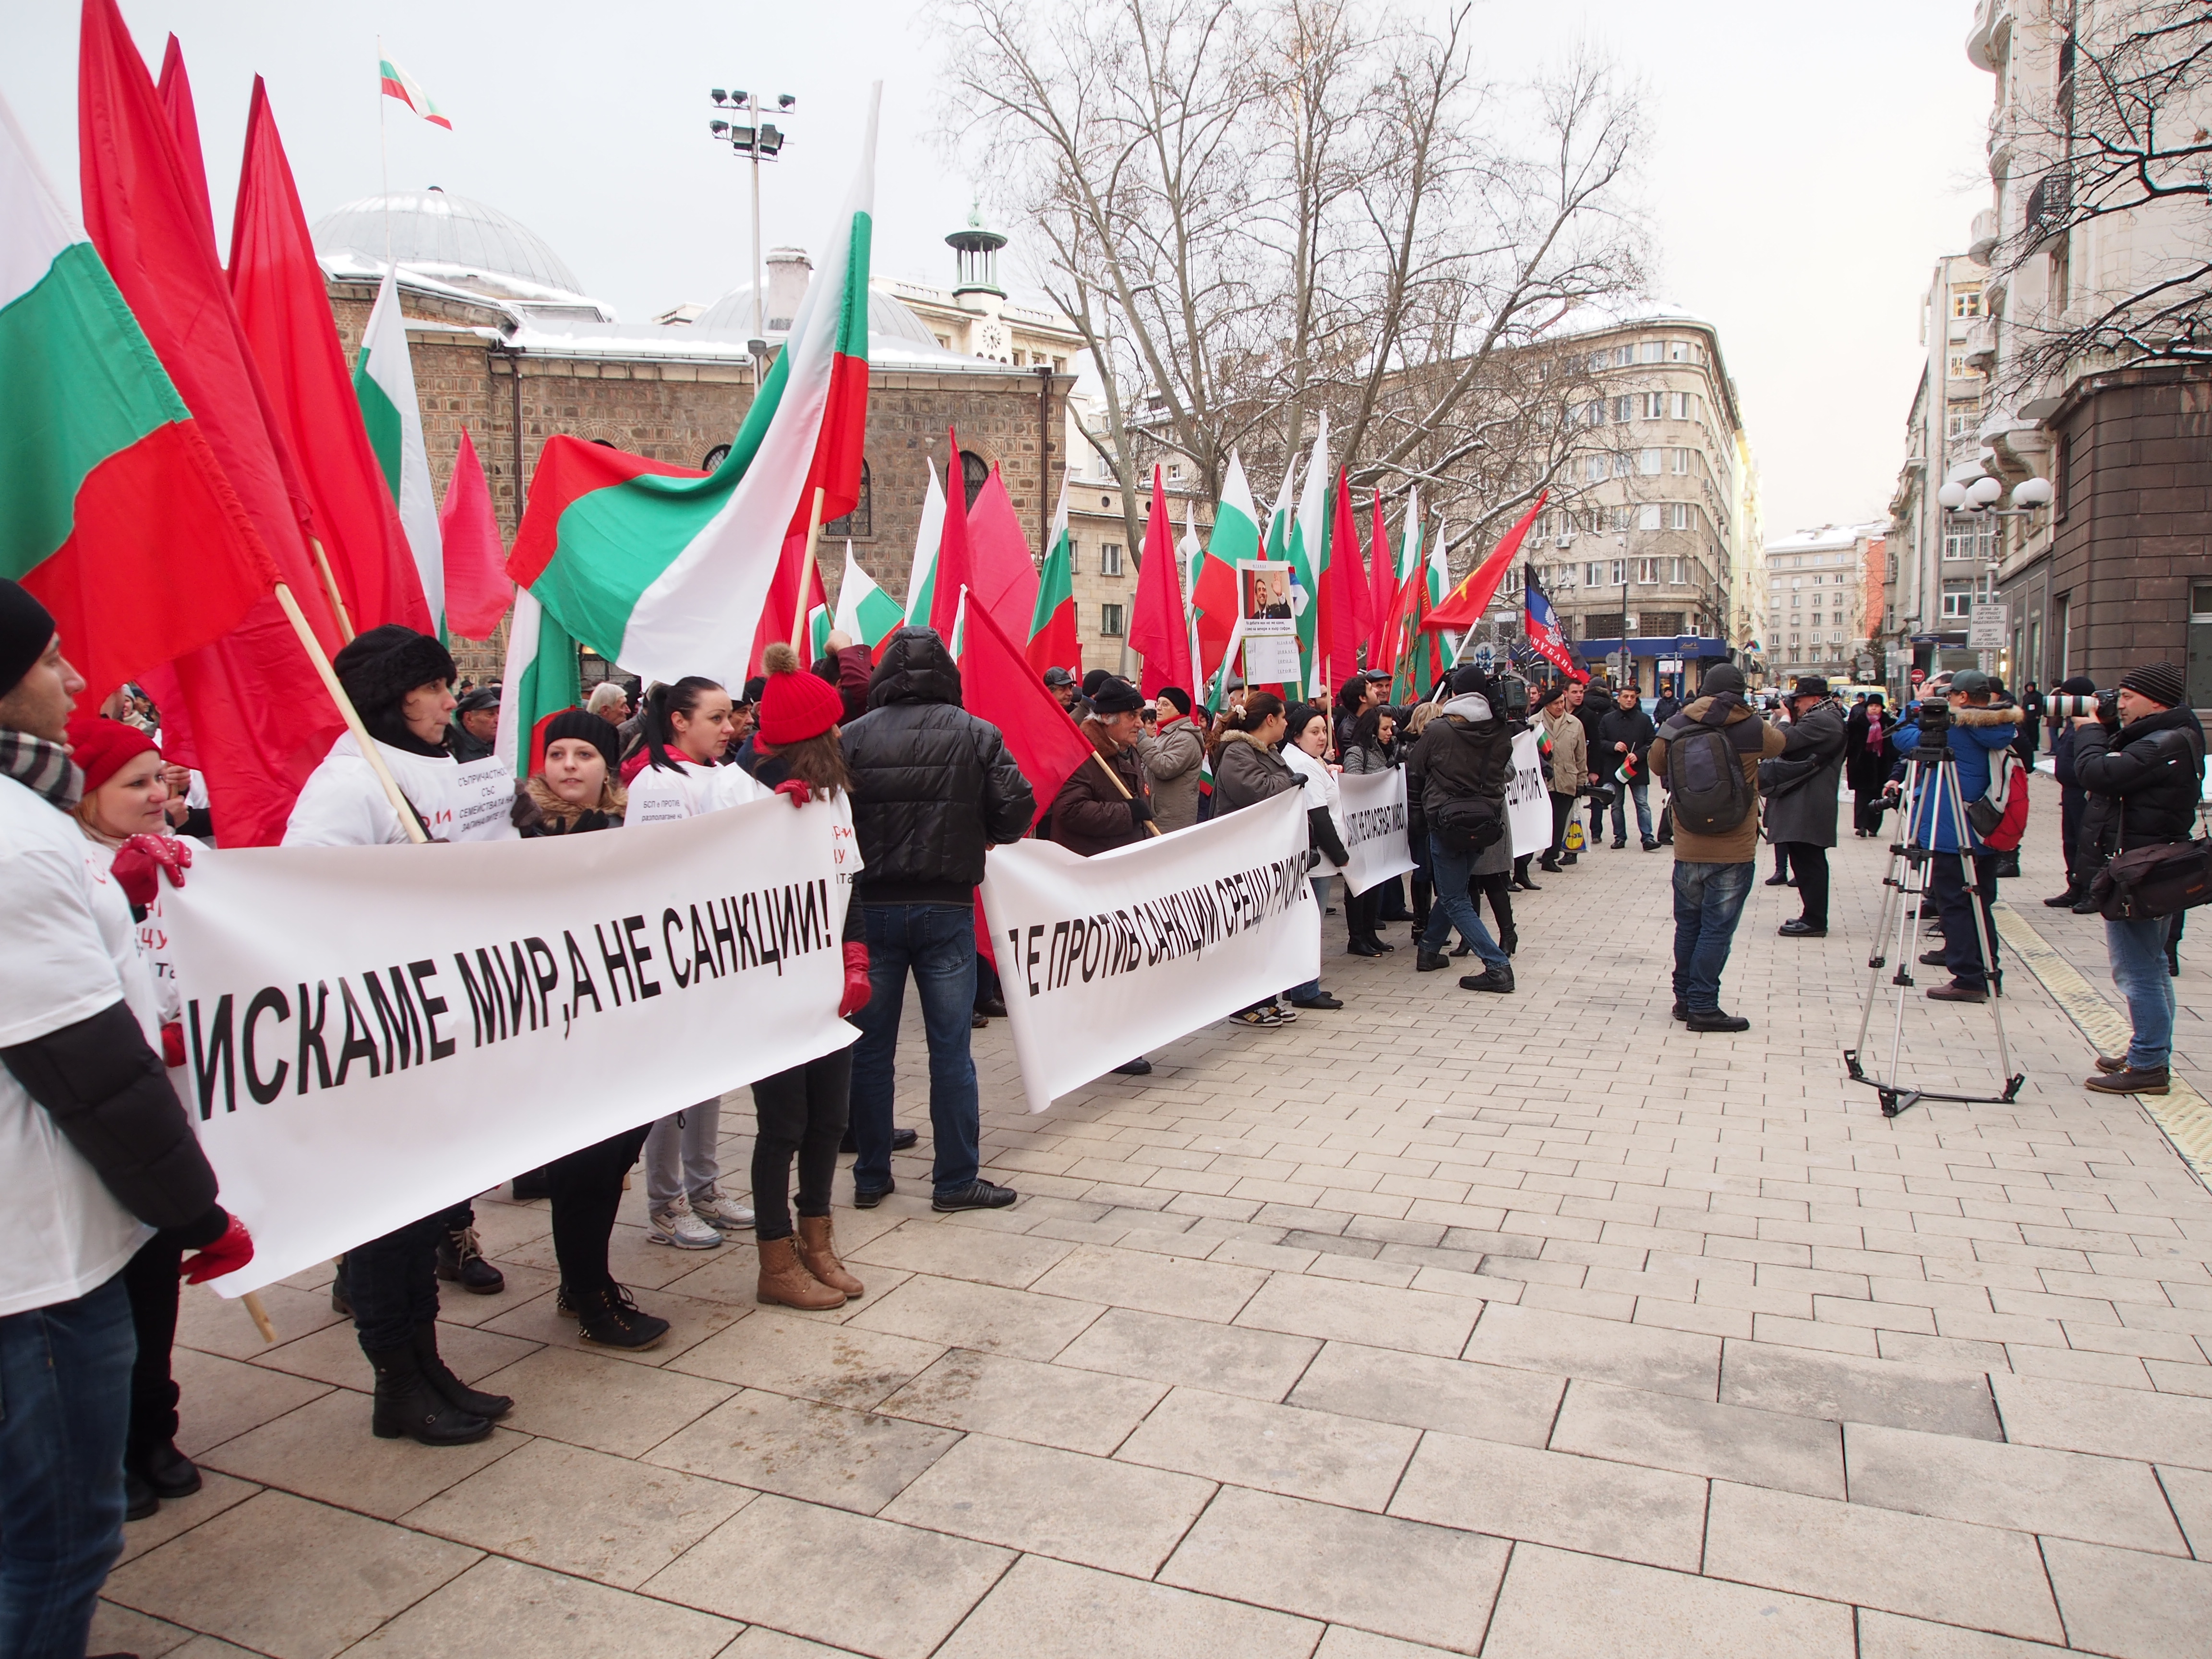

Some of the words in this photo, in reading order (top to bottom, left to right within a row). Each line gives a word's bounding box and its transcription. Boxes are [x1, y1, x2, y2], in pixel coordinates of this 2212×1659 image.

[481, 785, 495, 797] СЪС
[1518, 767, 1542, 803] РУСИЯ
[459, 798, 505, 818] СЕМЕЙСТВАТА
[641, 814, 676, 823] разполагане
[1357, 811, 1366, 841] НЕ
[1047, 909, 1142, 991] ПРОТИВ
[1133, 884, 1220, 967] САНКЦИИ
[1215, 866, 1271, 938] СРЕЩУ
[188, 959, 456, 1121] ИСКАМЕ
[594, 914, 661, 1008] НЕ
[662, 878, 832, 989] САНКЦИИ!
